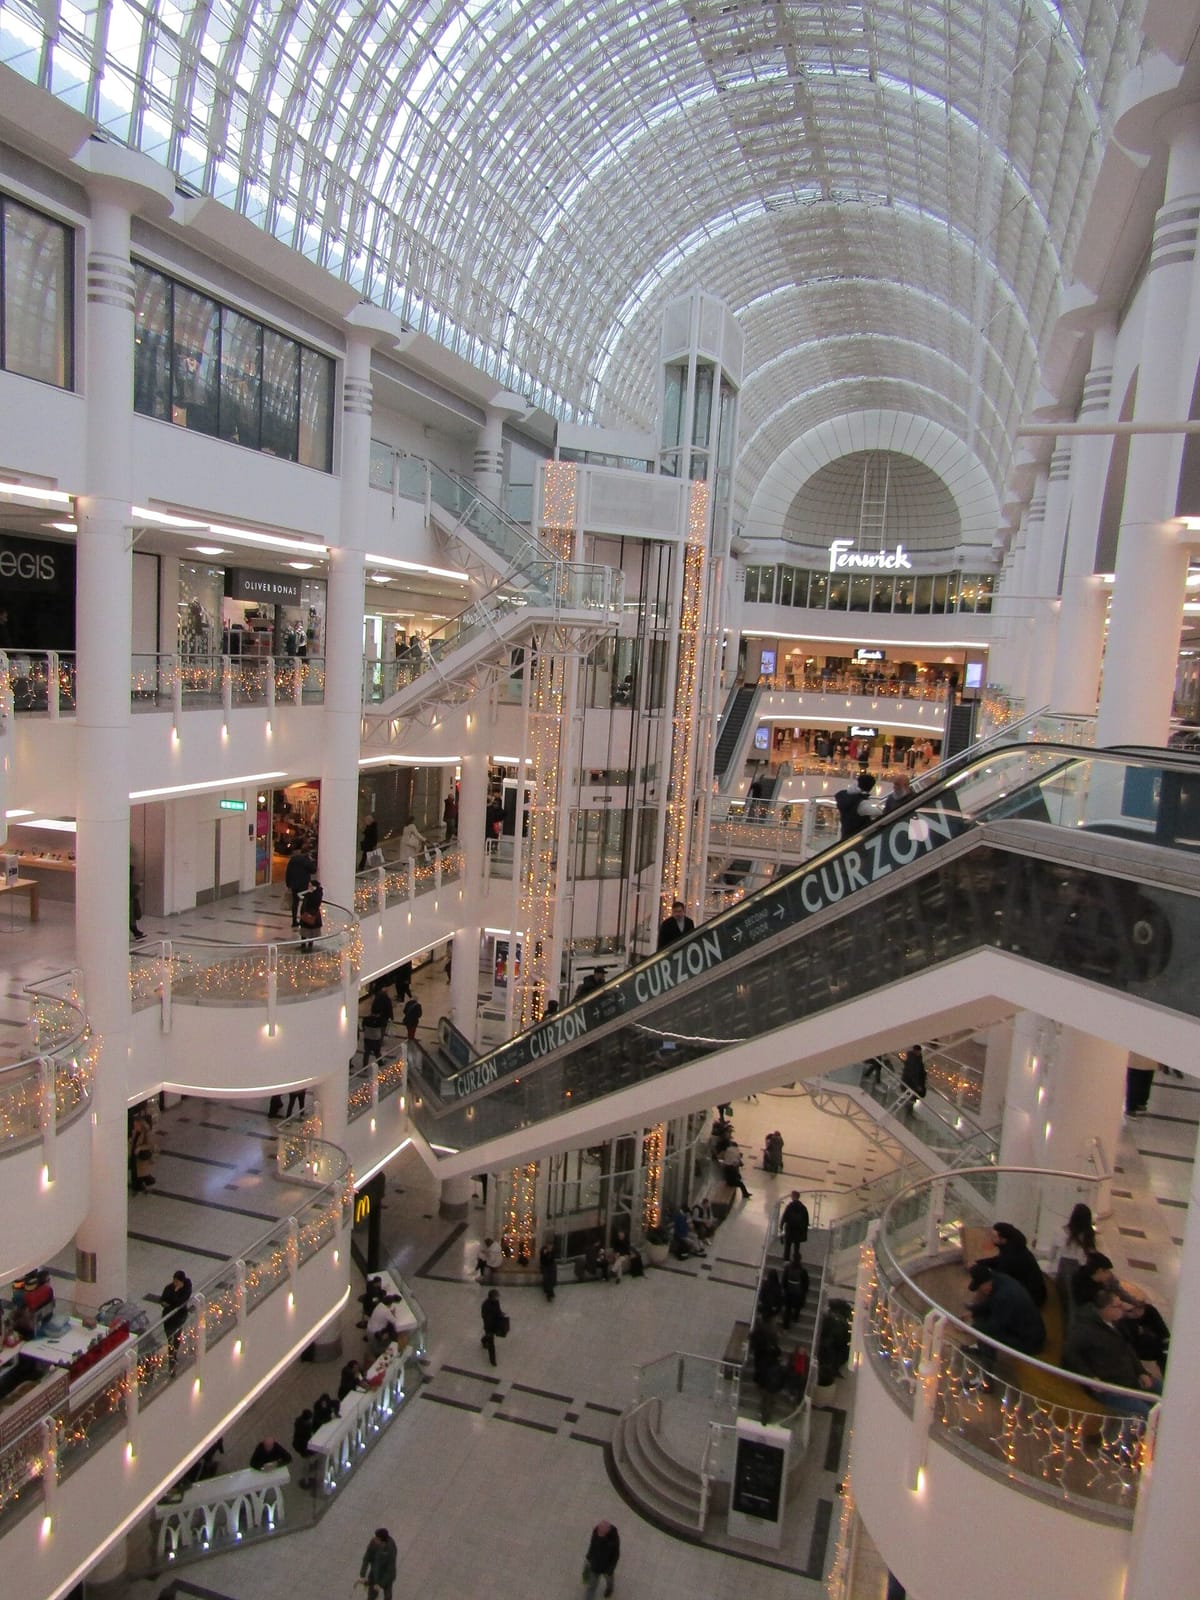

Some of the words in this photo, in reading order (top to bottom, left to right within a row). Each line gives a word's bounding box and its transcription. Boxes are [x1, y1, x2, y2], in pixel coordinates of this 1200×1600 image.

[828, 540, 912, 573] Fenwick
[244, 581, 271, 592] OLIVER
[273, 585, 297, 595] BONAS
[801, 800, 952, 912] CURZON
[635, 930, 722, 1002] CURZON
[530, 1008, 587, 1059] CURZON
[457, 1058, 498, 1097] CURZON
